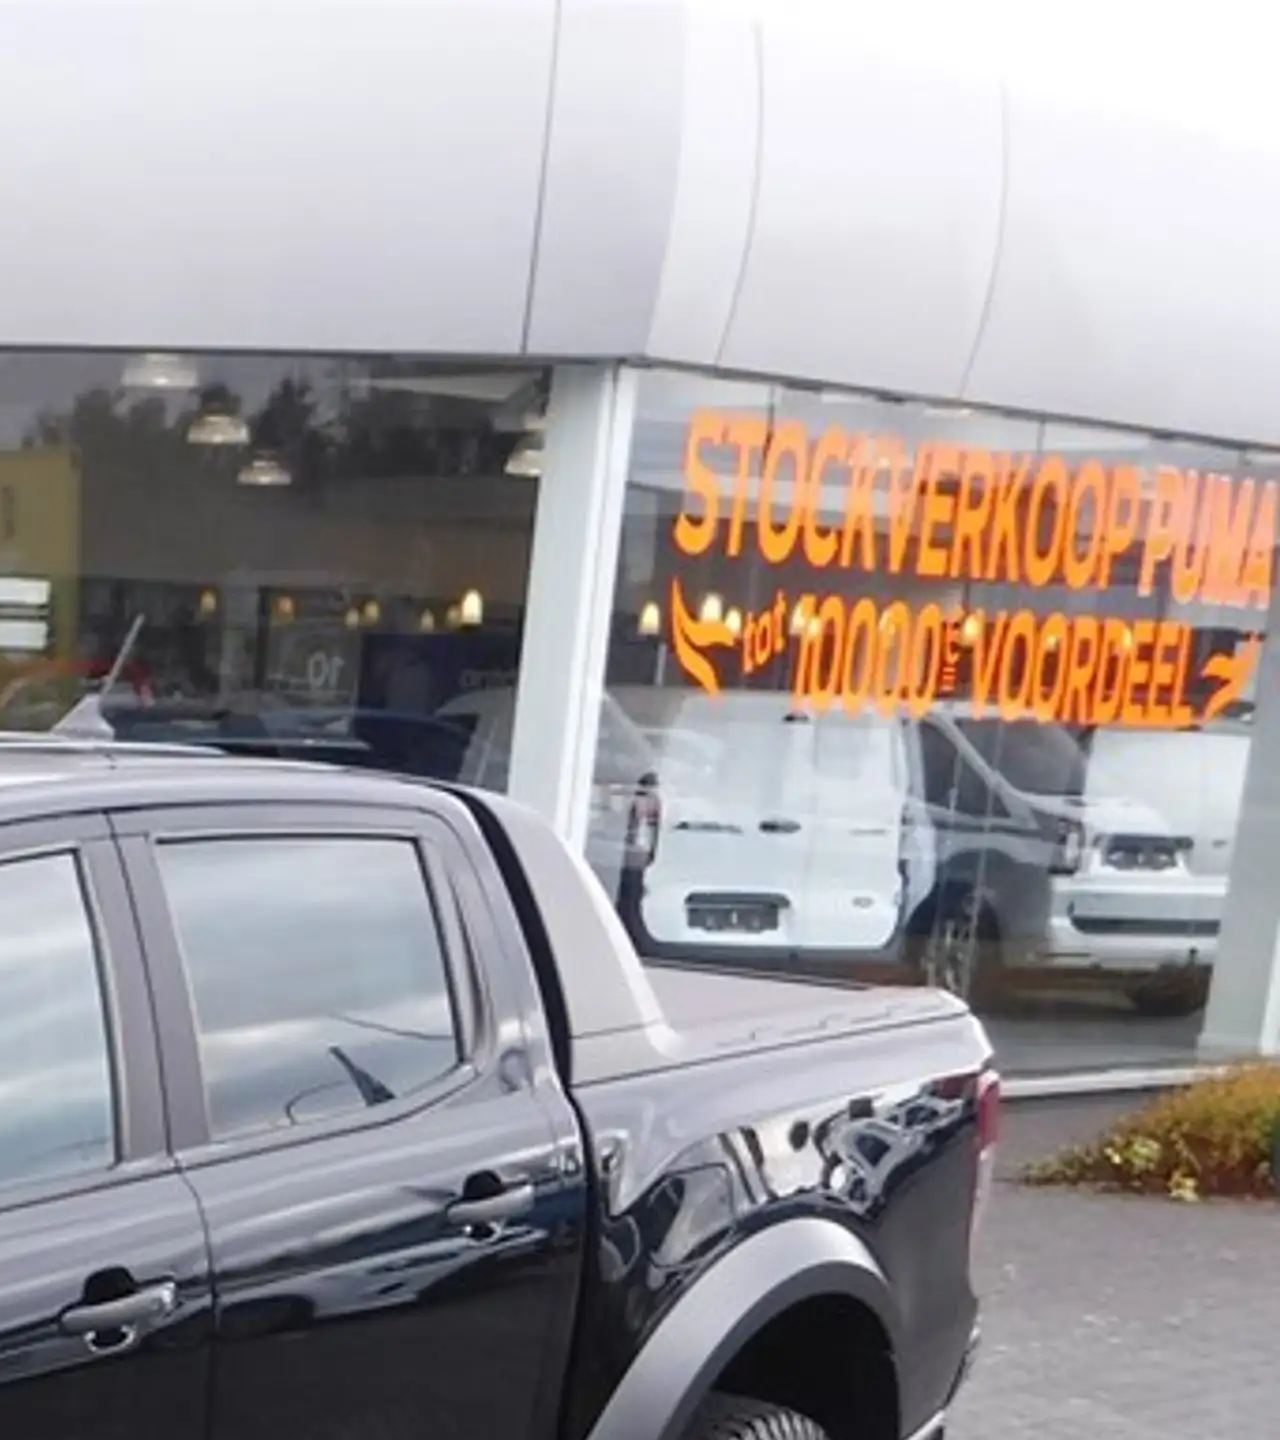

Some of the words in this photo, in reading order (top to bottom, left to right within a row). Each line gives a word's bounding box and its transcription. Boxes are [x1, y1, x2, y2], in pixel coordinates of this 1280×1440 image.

[1136, 465, 1279, 612] PUMA
[742, 590, 787, 675] tot
[968, 605, 1194, 728] VOORDEEL
